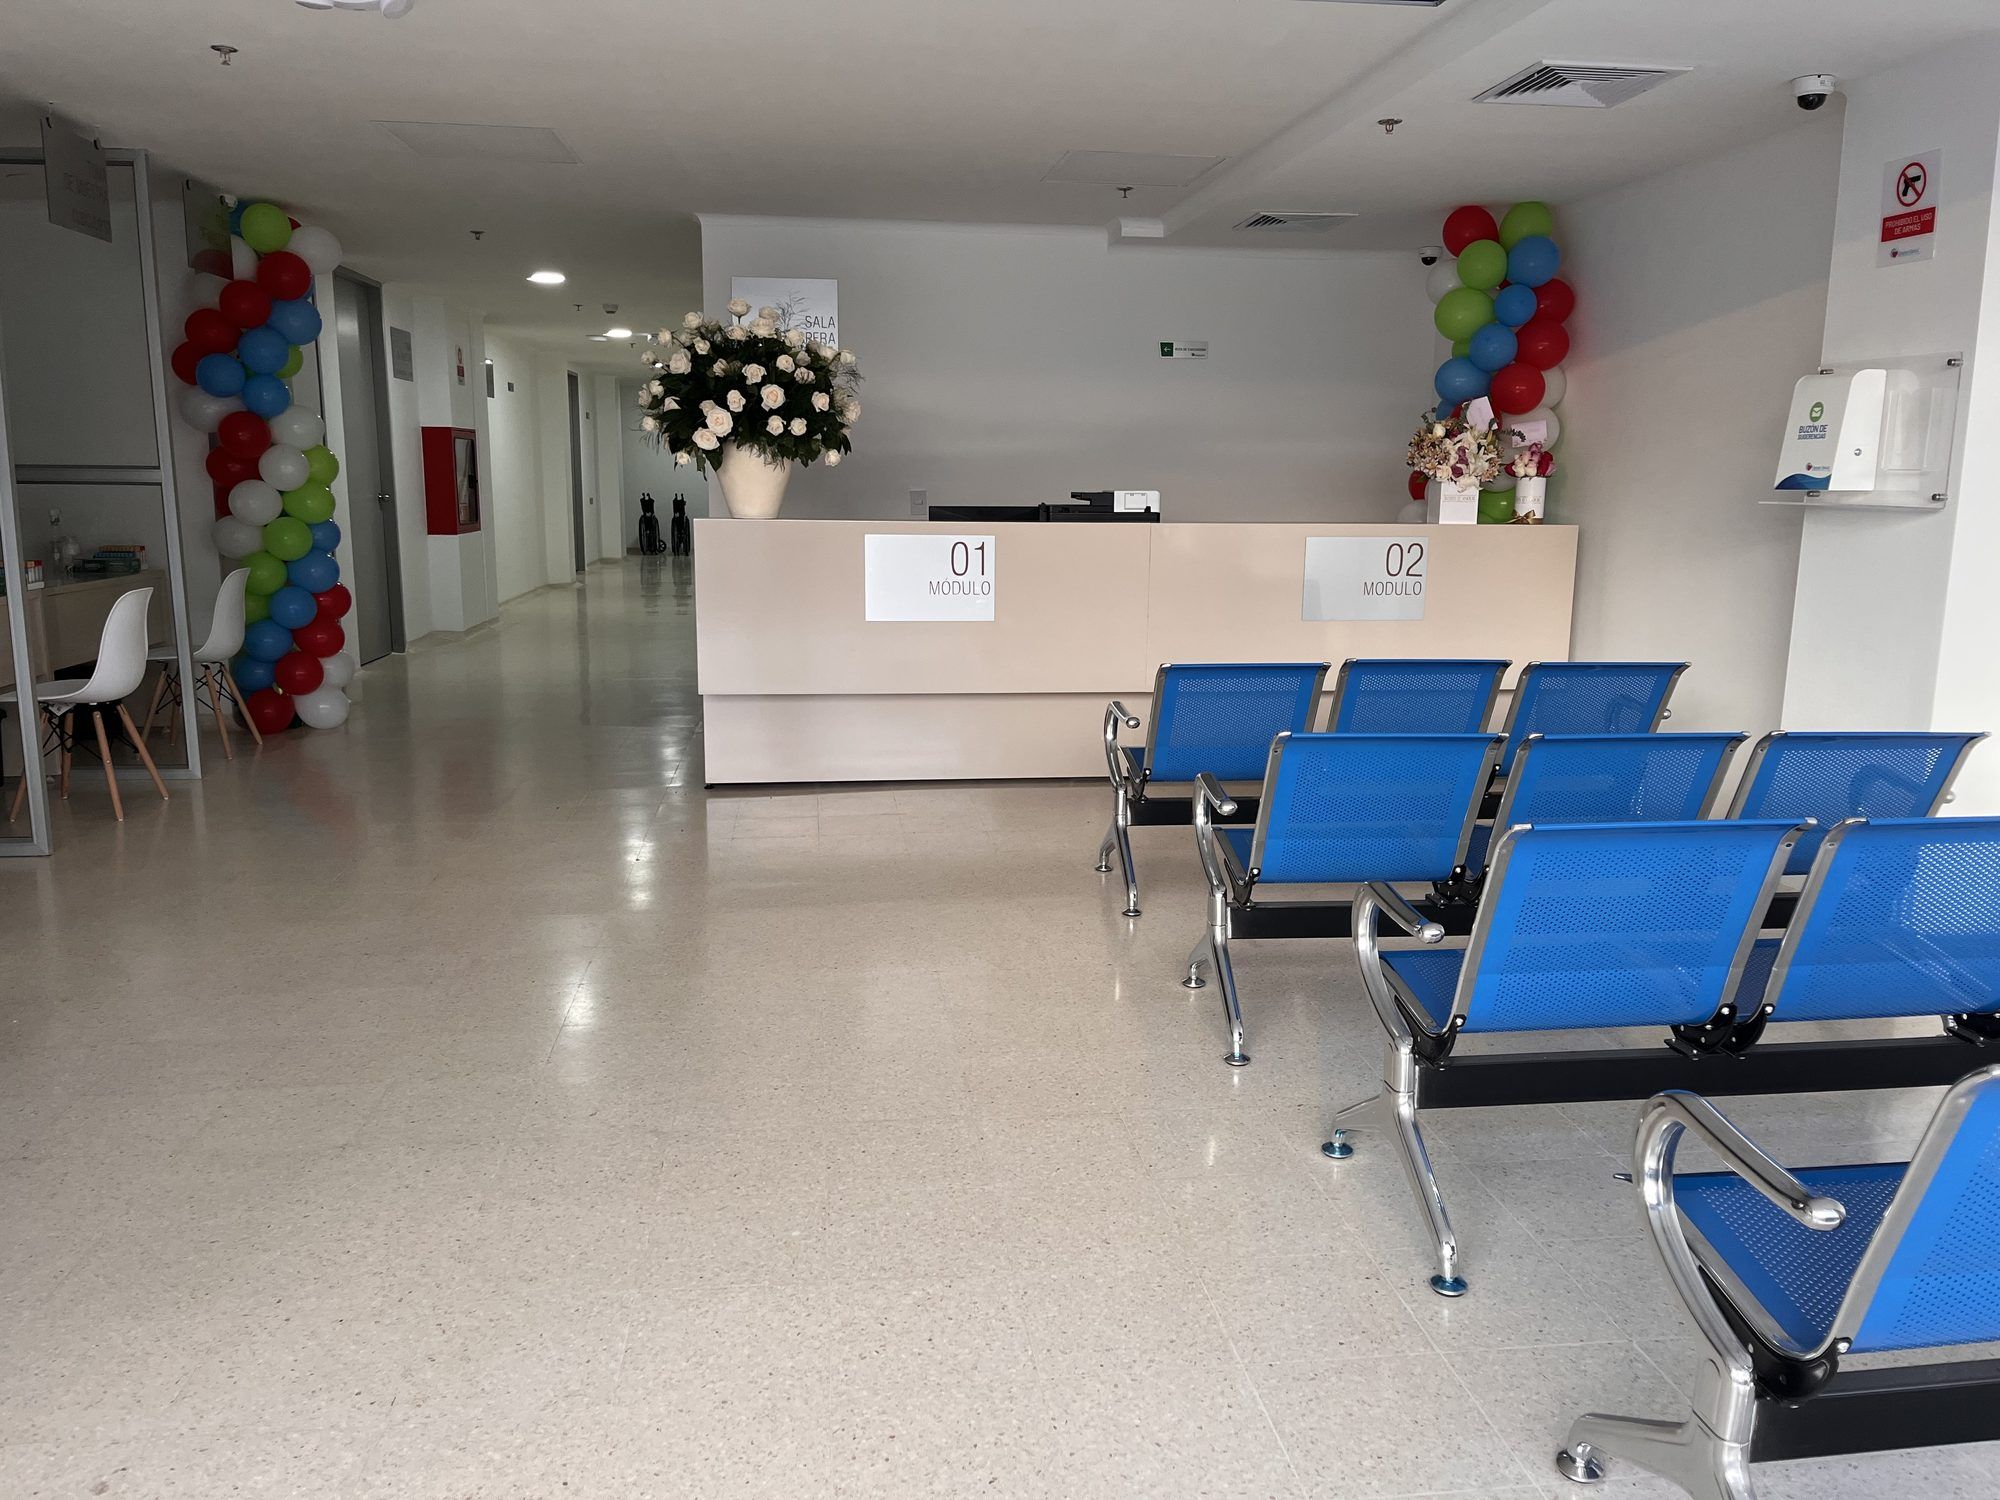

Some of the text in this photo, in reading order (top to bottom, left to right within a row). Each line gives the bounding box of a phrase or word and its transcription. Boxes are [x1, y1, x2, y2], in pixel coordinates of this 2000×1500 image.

[1885, 217, 1912, 228] PROHIBIDO
[1894, 223, 1921, 235] DE ARMAS
[805, 315, 836, 328] SALA
[805, 331, 836, 344] PERA
[1798, 424, 1828, 433] BUZÓN DE
[951, 541, 985, 576] 01
[1385, 542, 1424, 577] 02
[929, 578, 991, 596] MÓDULO
